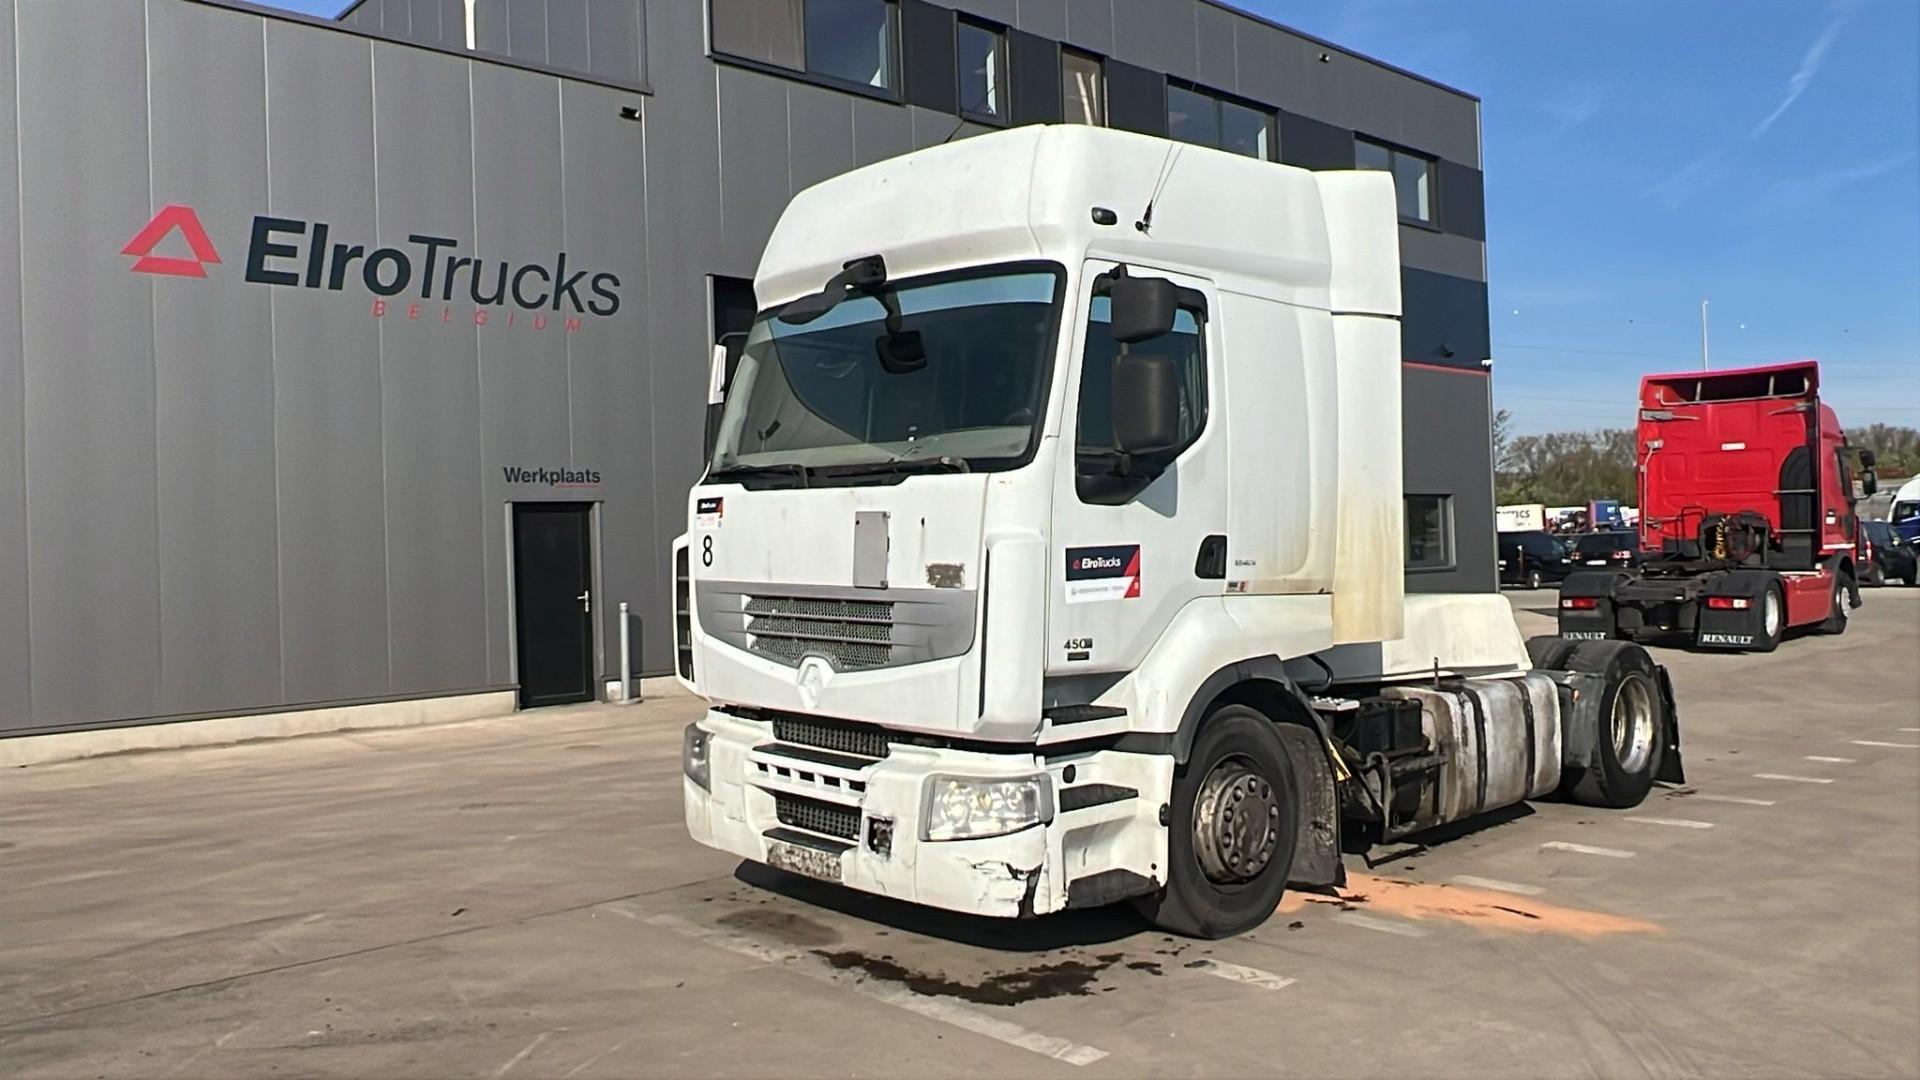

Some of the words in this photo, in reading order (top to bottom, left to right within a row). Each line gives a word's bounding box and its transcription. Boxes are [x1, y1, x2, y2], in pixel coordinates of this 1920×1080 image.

[245, 215, 621, 317] ElroTrucks
[371, 298, 582, 332] BELGIUM
[503, 466, 601, 486] Werkplaats
[702, 534, 713, 567] 8
[1081, 556, 1121, 569] ElroTrucks
[1562, 631, 1607, 641] RENAULT
[1702, 633, 1754, 645] RENAULT
